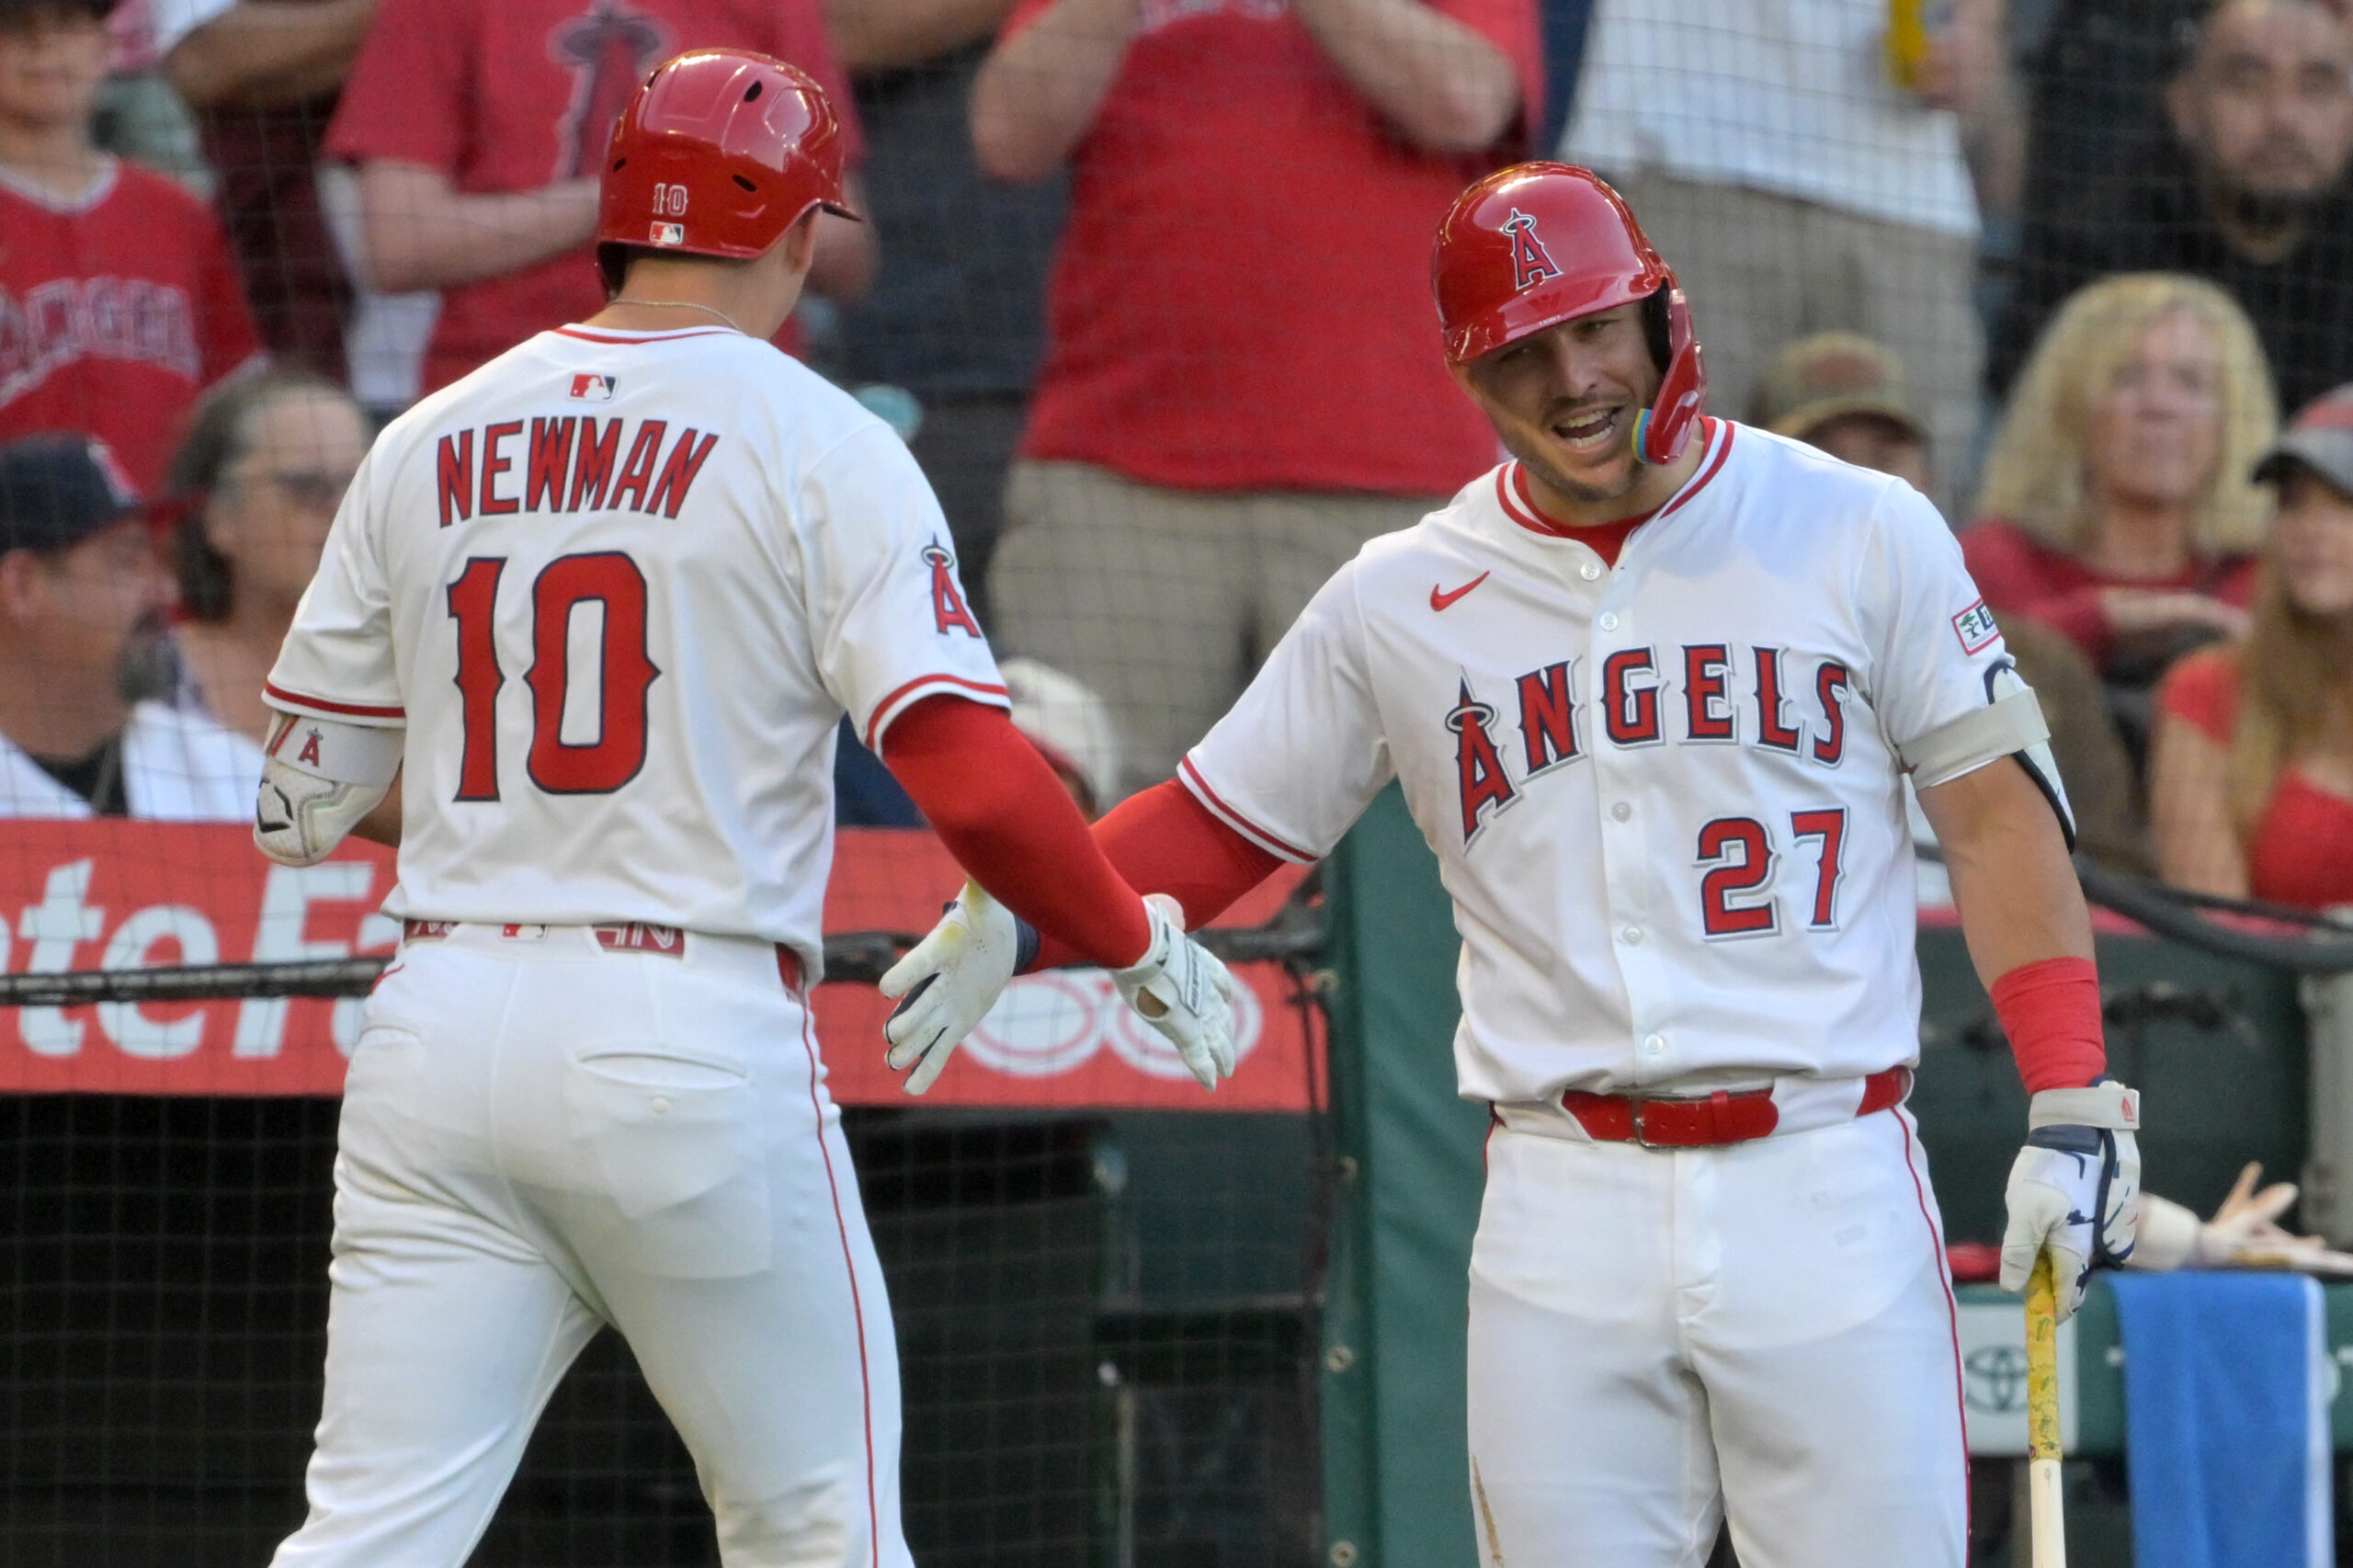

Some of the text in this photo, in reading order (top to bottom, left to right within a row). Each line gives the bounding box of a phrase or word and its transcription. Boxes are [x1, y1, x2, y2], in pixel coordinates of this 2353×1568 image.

[652, 182, 689, 216] 10
[1499, 207, 1563, 290] A
[437, 415, 721, 529] NEWMAN
[920, 531, 982, 639] A
[446, 551, 663, 802] 10
[297, 726, 324, 767] A
[1445, 643, 1849, 849] ANGELS
[1695, 805, 1848, 938] 27
[0, 858, 221, 1061] te
